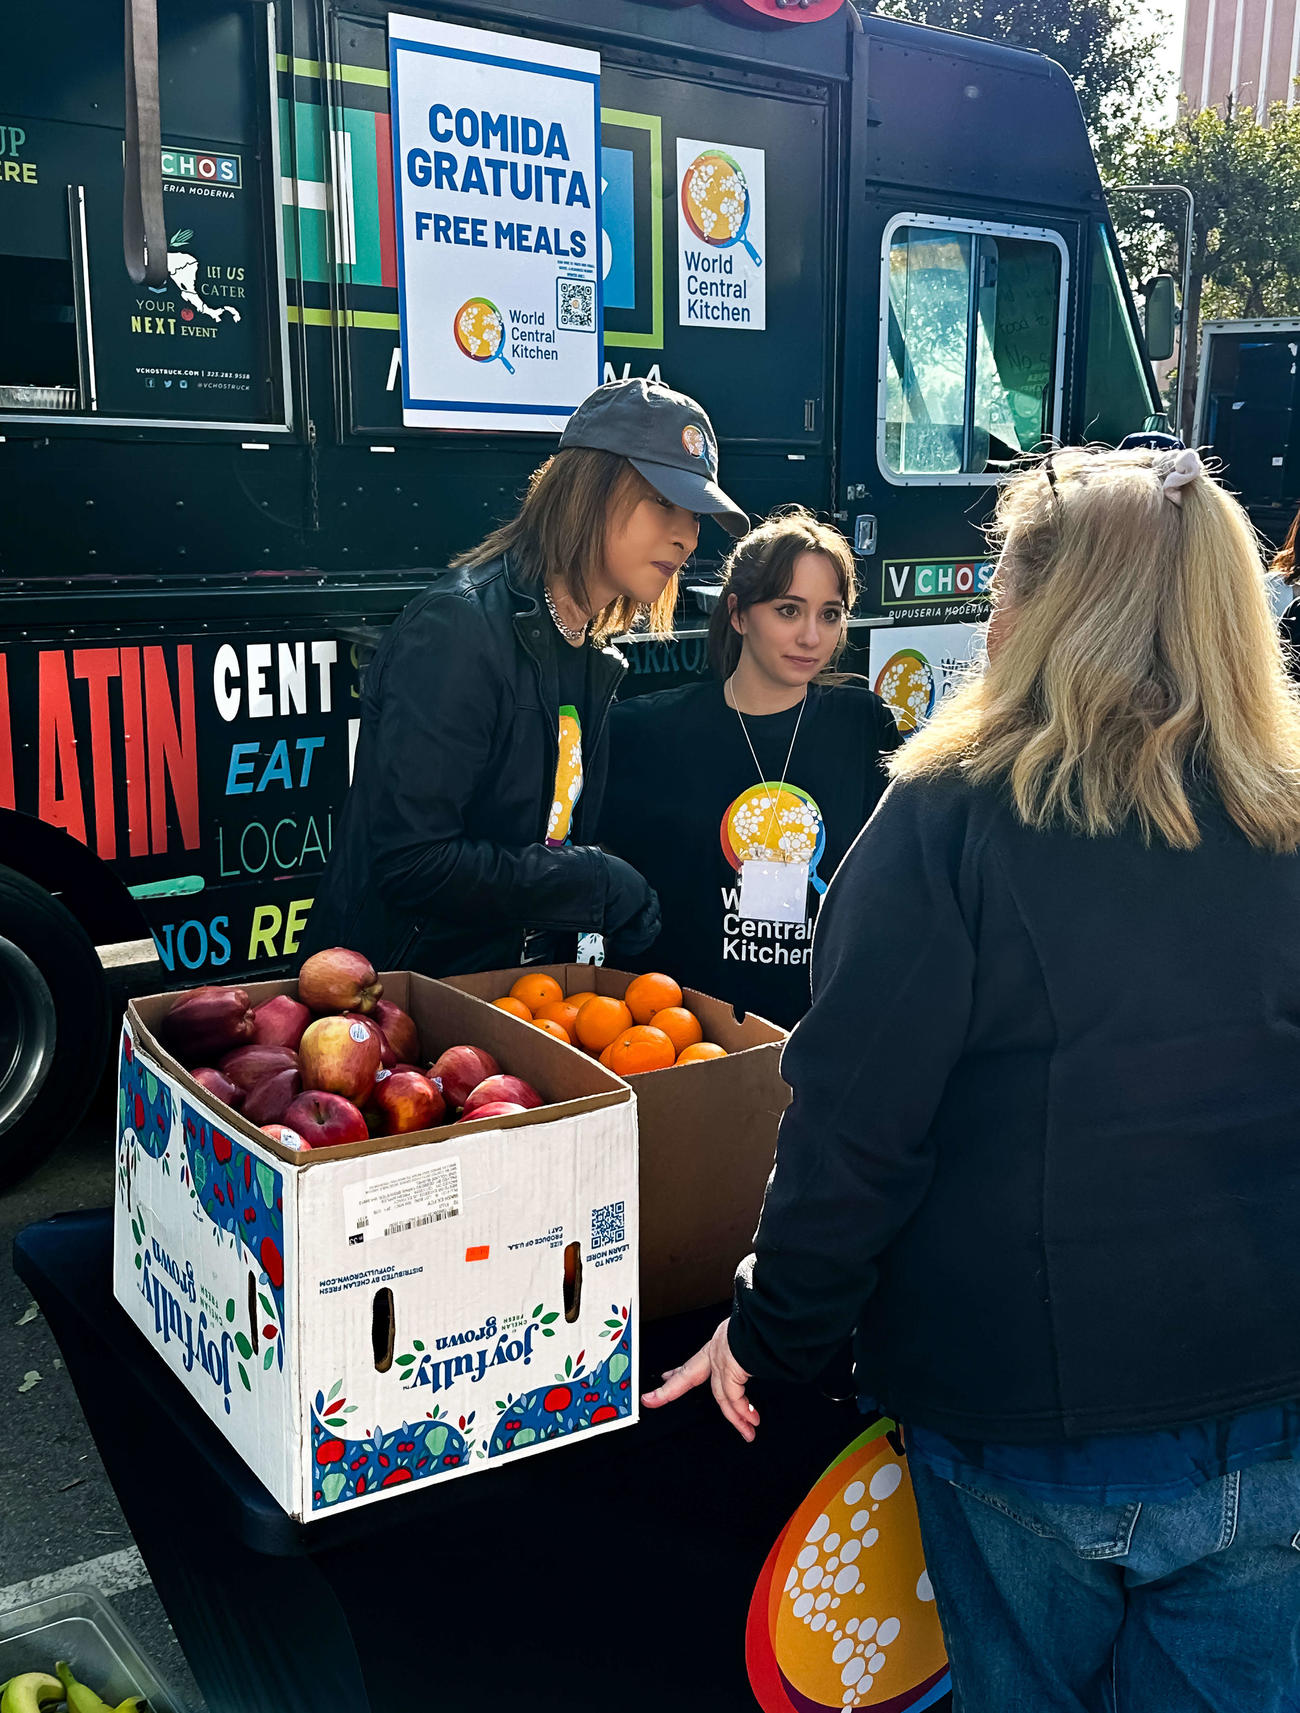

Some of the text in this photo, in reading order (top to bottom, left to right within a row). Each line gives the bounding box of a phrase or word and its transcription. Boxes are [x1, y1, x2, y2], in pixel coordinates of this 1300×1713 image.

[428, 103, 570, 161] COMIDA
[161, 154, 234, 180] CHOS
[407, 147, 591, 209] GRATUITA
[189, 187, 235, 199] MODERNA
[415, 211, 586, 258] FREE MEALS
[684, 250, 733, 275] World
[207, 265, 245, 281] LET US
[201, 283, 246, 298] CATER
[687, 274, 747, 300] Central
[136, 299, 175, 312] YOUR
[687, 298, 751, 324] Kitchen
[131, 315, 218, 338] NEXT EVENT
[509, 309, 545, 326] World
[511, 326, 556, 344] Central
[511, 343, 558, 361] Kitchen
[135, 367, 199, 376] VCHOSTRUCK.COM
[888, 564, 994, 598] VCHOS
[888, 607, 941, 619] PUPUSERIA
[225, 736, 326, 796] EAT
[723, 913, 813, 940] Central
[534, 1232, 564, 1244] PRODUCE
[551, 1225, 564, 1233] CAT
[525, 1239, 535, 1247] OF
[608, 1243, 630, 1255] LEARN
[151, 1236, 197, 1304] grown
[594, 1253, 624, 1268] SCAN TO
[319, 1266, 424, 1295] DISTRIBUTED BY CHELAN FRESH
[435, 1316, 498, 1351] grown
